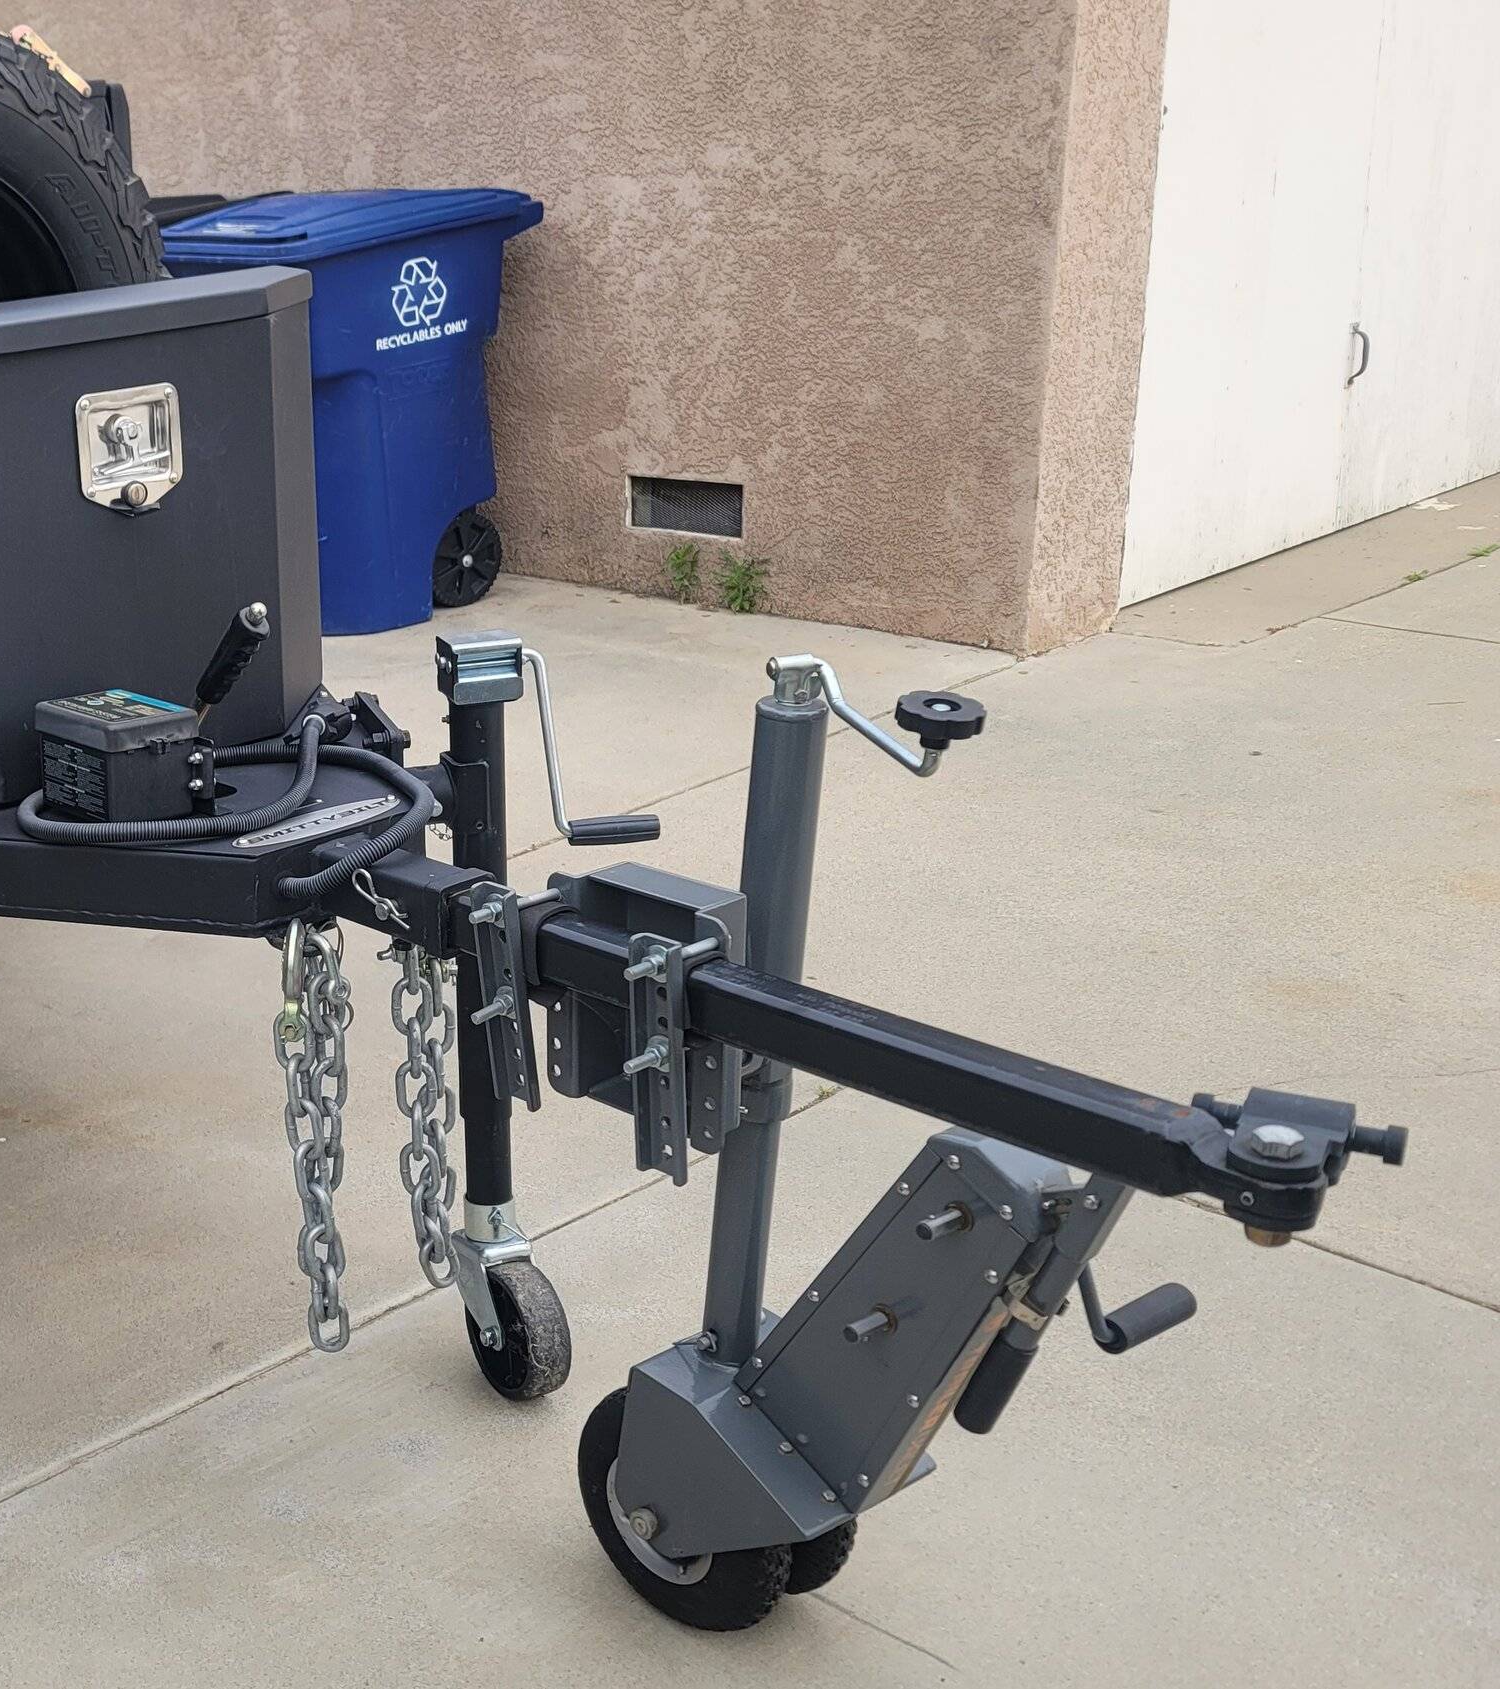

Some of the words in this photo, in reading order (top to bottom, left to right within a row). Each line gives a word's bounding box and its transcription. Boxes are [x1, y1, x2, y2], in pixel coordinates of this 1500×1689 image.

[376, 325, 442, 351] RECYCLABLES
[444, 318, 468, 335] ONLY
[247, 800, 388, 845] SMITTYBILT
